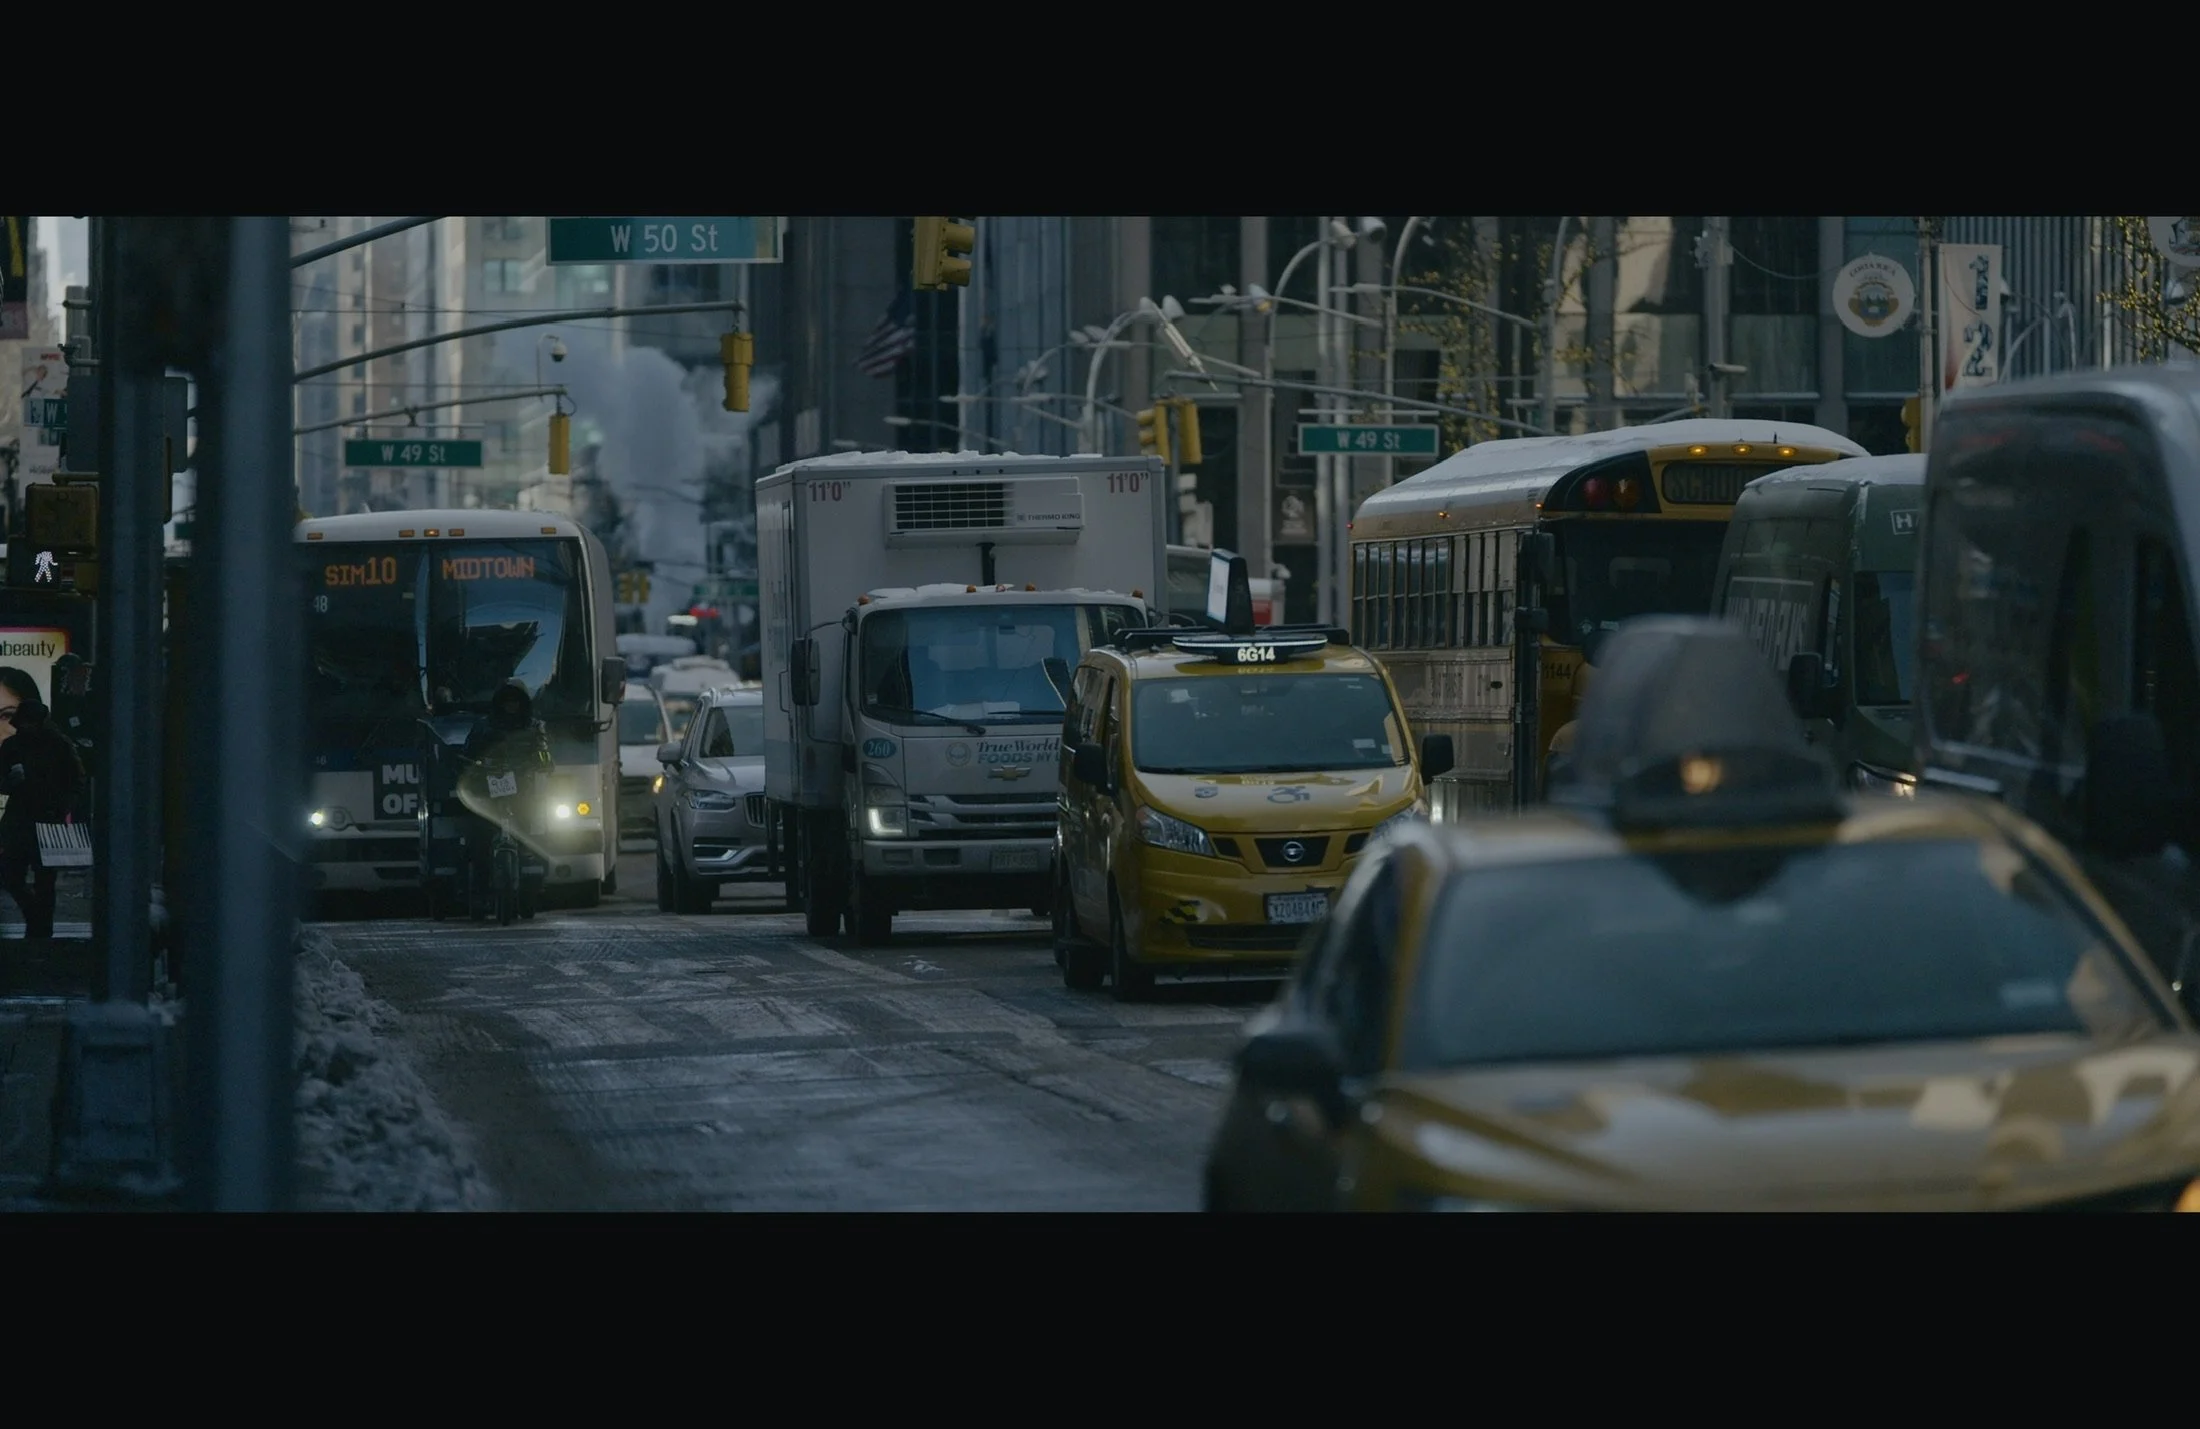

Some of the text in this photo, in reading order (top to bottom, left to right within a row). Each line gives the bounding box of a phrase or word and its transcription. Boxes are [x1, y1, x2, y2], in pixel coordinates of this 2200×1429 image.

[610, 224, 719, 253] W 50 St
[1336, 430, 1402, 450] W 49 St
[380, 443, 447, 463] W 49 St
[1027, 512, 1081, 521] THERMO KING
[325, 556, 397, 586] SIM10
[442, 556, 535, 580] MIDTOWN
[1237, 646, 1276, 663] 6G14
[867, 742, 890, 757] 260
[977, 752, 1033, 764] FOODS
